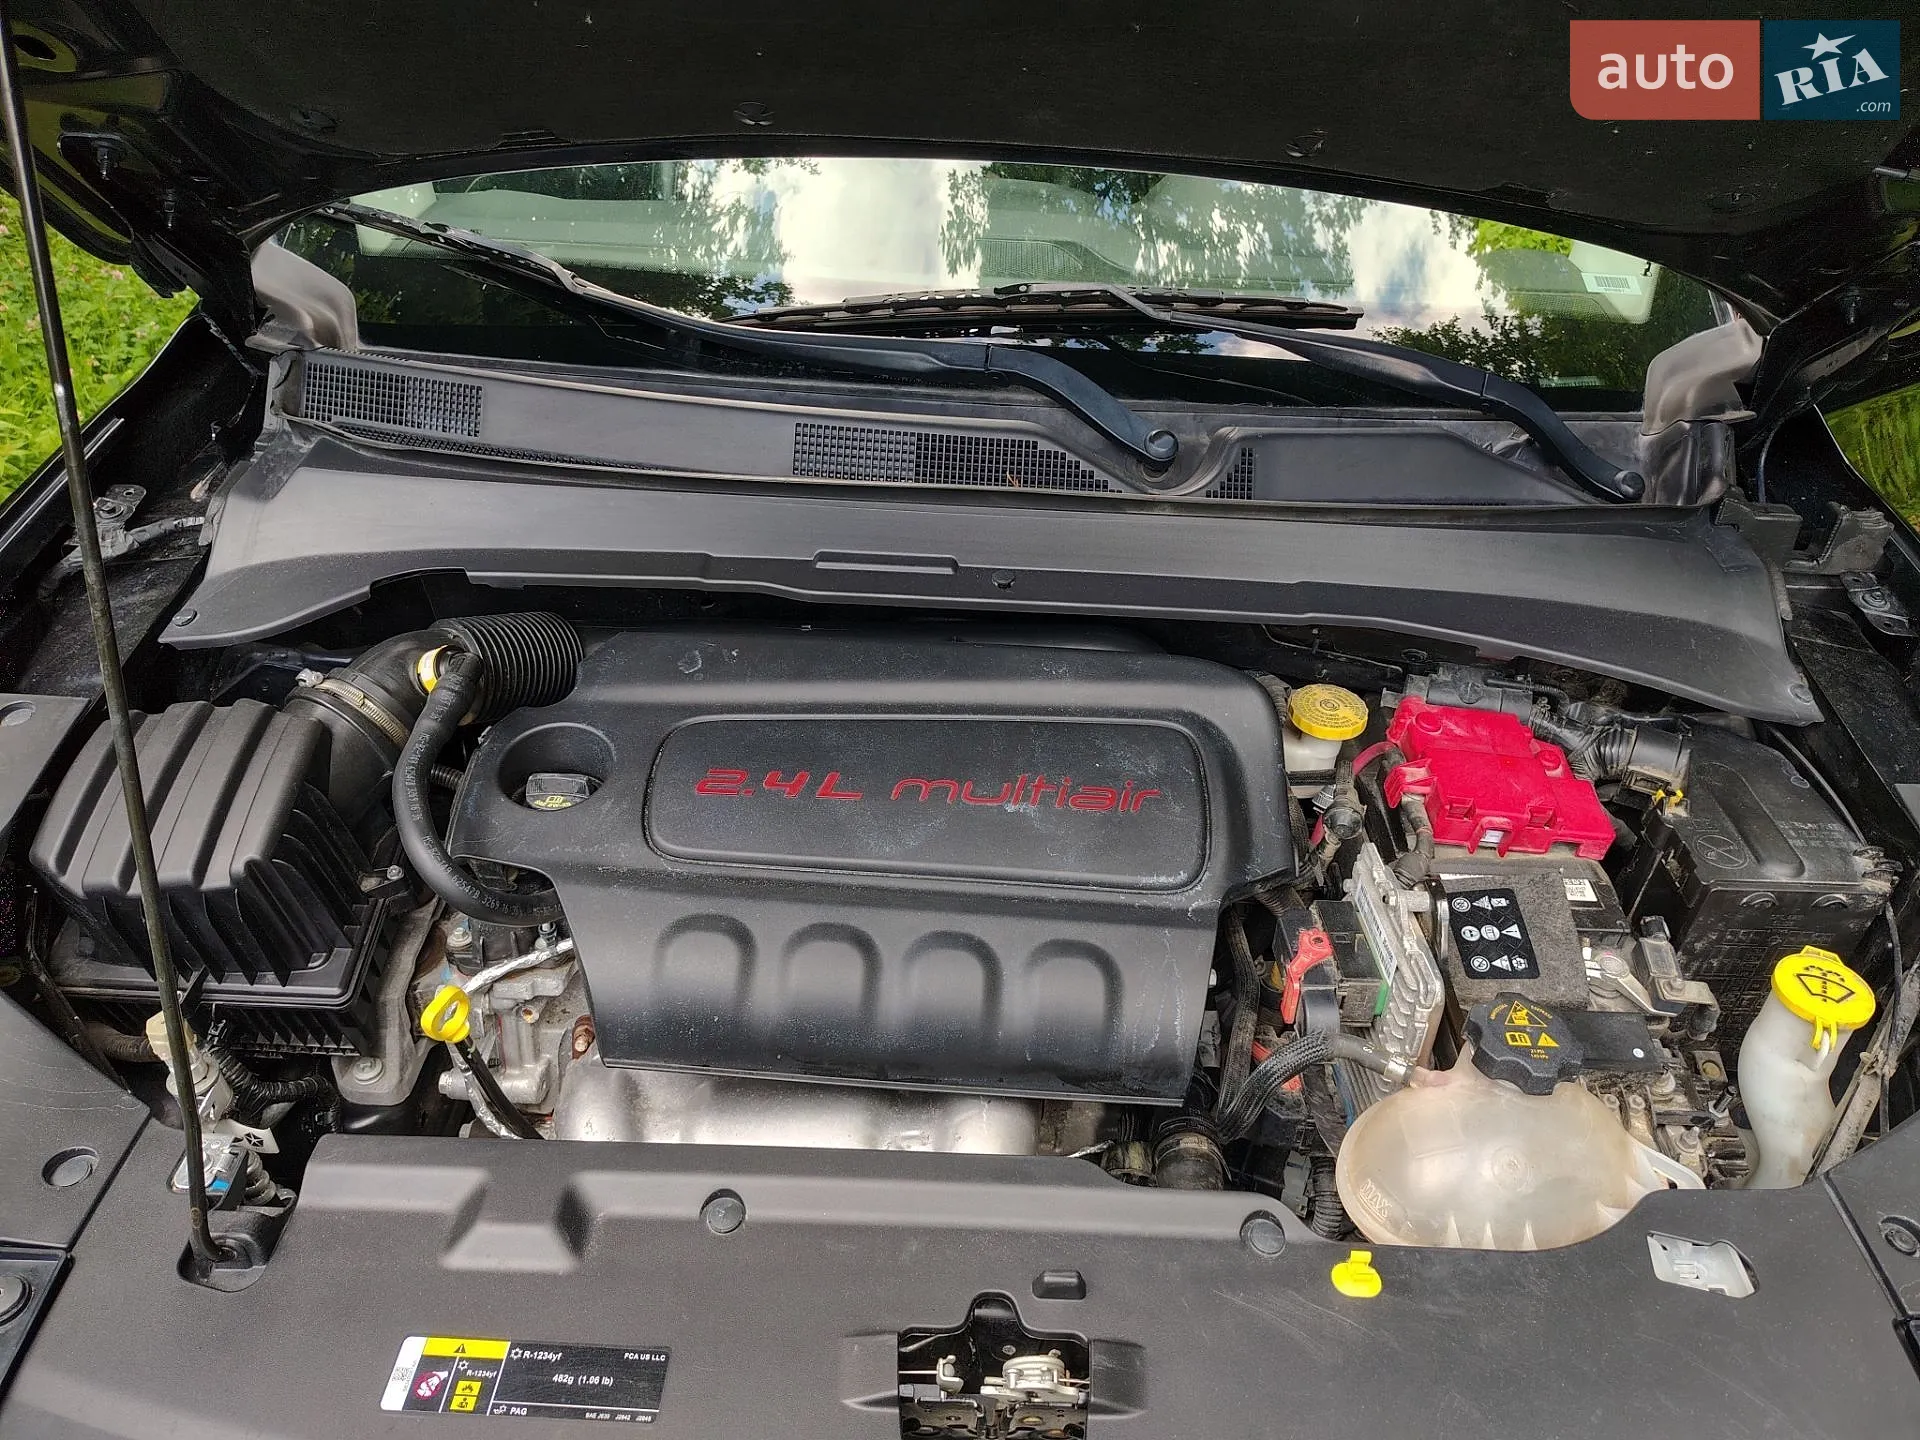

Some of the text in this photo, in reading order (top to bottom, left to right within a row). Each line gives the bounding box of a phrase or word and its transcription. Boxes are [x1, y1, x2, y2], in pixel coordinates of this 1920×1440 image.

[890, 772, 1161, 814] multiair
[1359, 1178, 1393, 1218] MAX
[523, 1350, 563, 1362] R-1234yf
[624, 1352, 666, 1362] FCA US LLC
[578, 1375, 601, 1386] (1.06
[601, 1376, 614, 1388] lb)
[510, 1406, 528, 1416] PAG
